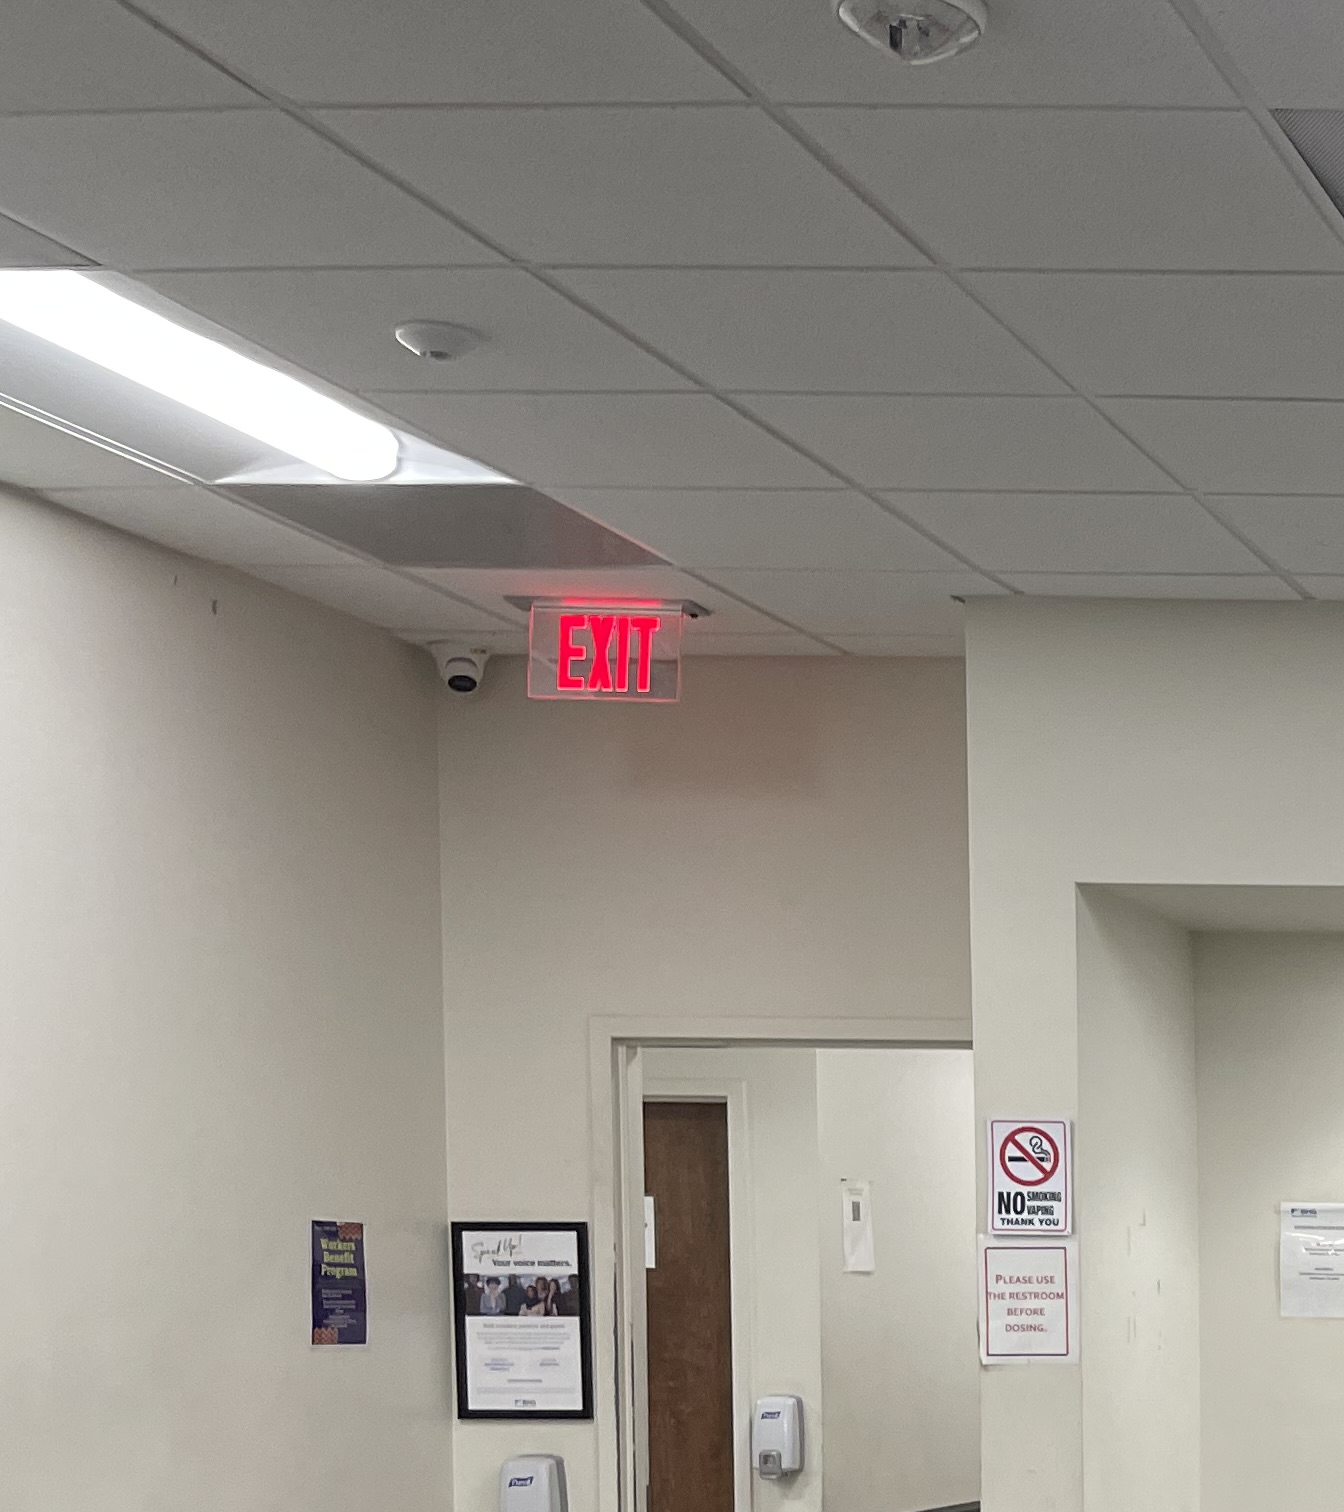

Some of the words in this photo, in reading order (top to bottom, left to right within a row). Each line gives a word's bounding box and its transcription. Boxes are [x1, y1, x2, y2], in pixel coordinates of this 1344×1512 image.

[557, 614, 662, 693] EXIT
[1026, 1191, 1062, 1203] SMOKING
[997, 1191, 1026, 1216] NO
[1026, 1204, 1055, 1216] VAPING
[999, 1217, 1035, 1226] THANK
[1038, 1217, 1060, 1227] YOU
[320, 1238, 356, 1251] Workers
[323, 1251, 355, 1264] Benefit
[492, 1259, 511, 1267] Your
[537, 1259, 572, 1267] matters.
[320, 1263, 358, 1279] Program
[1036, 1275, 1055, 1284] USE
[988, 1292, 1006, 1300] THE
[1009, 1291, 1064, 1300] RESTROOM
[1007, 1307, 1046, 1316] BEFORE
[1005, 1324, 1047, 1333] DOSING.
